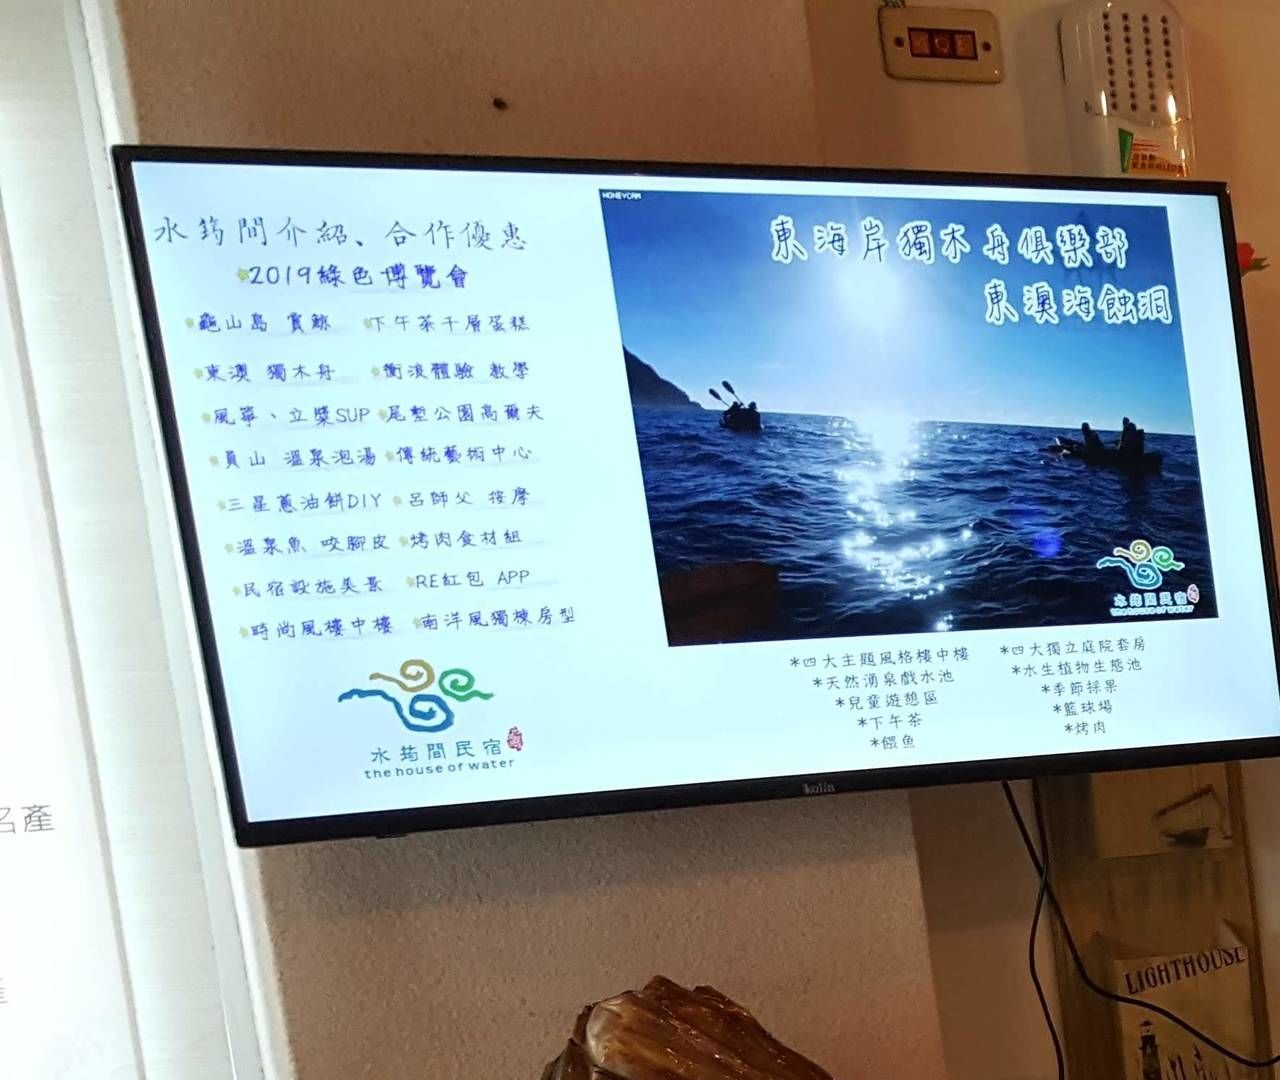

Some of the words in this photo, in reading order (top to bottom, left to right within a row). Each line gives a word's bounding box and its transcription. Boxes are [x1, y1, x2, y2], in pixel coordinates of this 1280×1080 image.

[769, 215, 1129, 270] 東海岸獨木舟俱樂部
[246, 261, 469, 291] 2019綠色博覽會
[985, 277, 1173, 325] 東澳海蝕洞
[198, 311, 268, 333] 龜山島
[286, 311, 332, 334] 賞鯨
[371, 314, 530, 333] 下午茶千層蛋糕
[204, 363, 251, 383] 東澳
[266, 363, 335, 383] 獨木舟
[382, 361, 475, 381] 衝浪體驗
[489, 361, 530, 381] 教學
[225, 449, 266, 470] 員山
[283, 446, 377, 468] 溫泉泡湯
[395, 444, 532, 465] 傳統藝術中心
[409, 490, 473, 508] 呂師父
[488, 486, 530, 506] 按摩
[236, 536, 307, 557] 溫泉魚
[319, 533, 390, 552] 咬腳皮
[409, 528, 523, 550] 烤肉食材組
[243, 575, 383, 598] 民宿設施美景
[415, 570, 485, 589] RE紅包
[497, 569, 530, 585] APP
[250, 615, 393, 641] 時尚風樓中樓
[419, 605, 576, 631] 南洋風獨棟房型
[1011, 635, 1145, 657] 四大獨立庭院套房
[802, 646, 970, 672] 四大主題風格樓中樓
[1023, 657, 1143, 678] 水生植物生態池
[824, 666, 955, 693] 天然湧泉戲水池
[1053, 678, 1118, 697] 季節採果
[848, 689, 938, 711] 兒童遊憩區
[1063, 699, 1113, 717] 籃球場
[869, 711, 922, 730] 下午茶
[1074, 720, 1106, 736] 烤肉
[363, 769, 393, 780] the
[395, 764, 445, 777] house
[447, 762, 465, 773] of
[467, 758, 516, 771] water
[1124, 946, 1247, 996] LIGHTHOUSE
